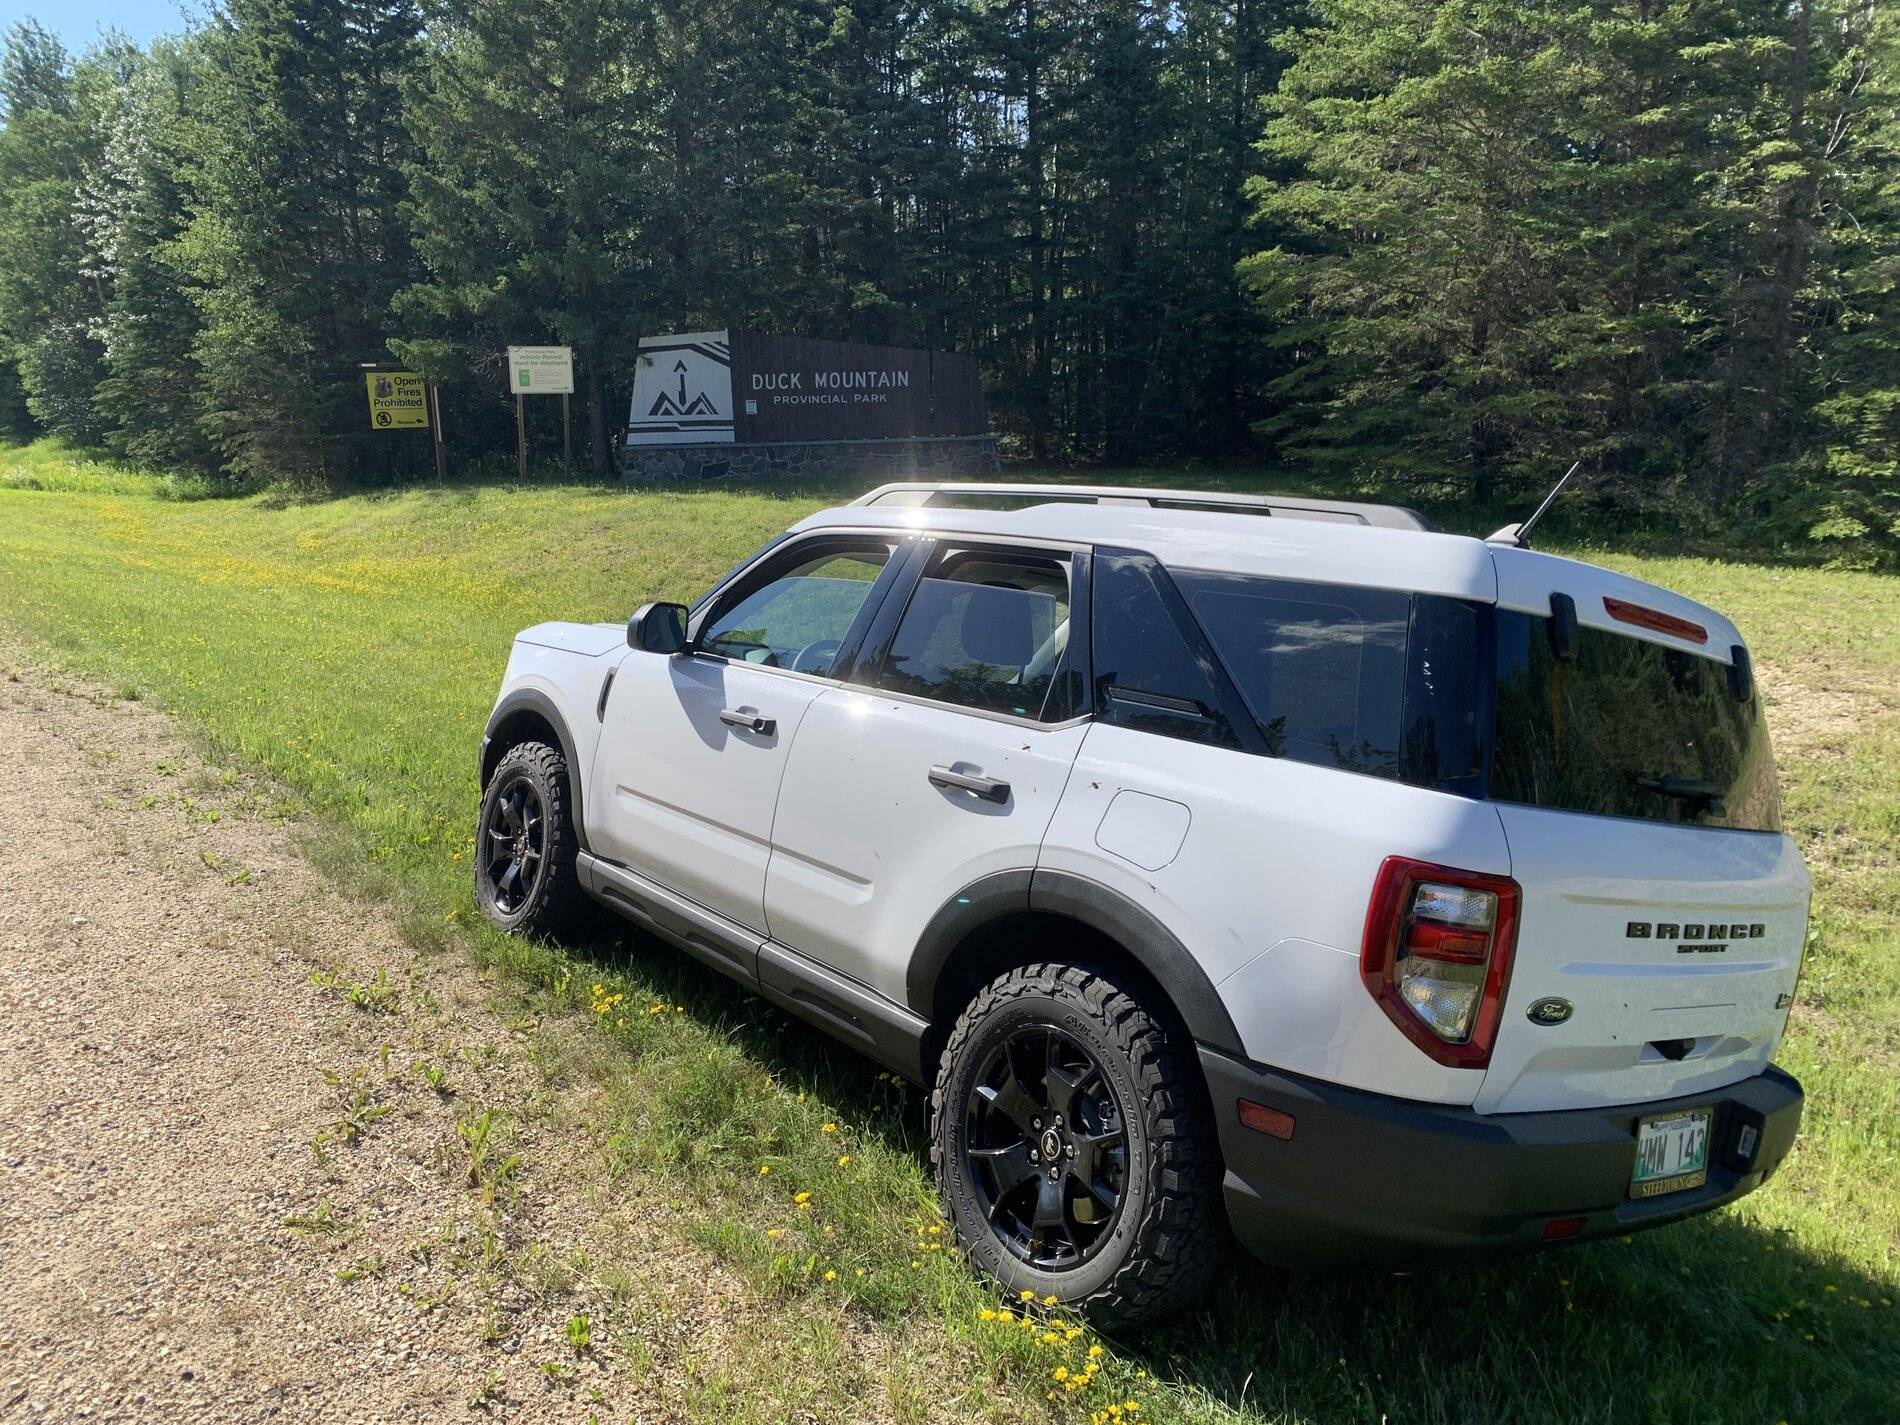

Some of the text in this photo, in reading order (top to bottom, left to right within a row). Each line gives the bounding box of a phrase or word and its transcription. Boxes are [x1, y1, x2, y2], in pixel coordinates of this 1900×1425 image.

[393, 376, 421, 387] Open
[752, 370, 910, 390] DUCK MOUNTAIN
[397, 387, 421, 397] Fires
[373, 397, 423, 408] Prohibited
[773, 394, 888, 405] PROVINCIAL PARK
[1625, 921, 1766, 940] BRONCO
[1677, 944, 1730, 954] SPORT
[1539, 1003, 1567, 1019] Ford
